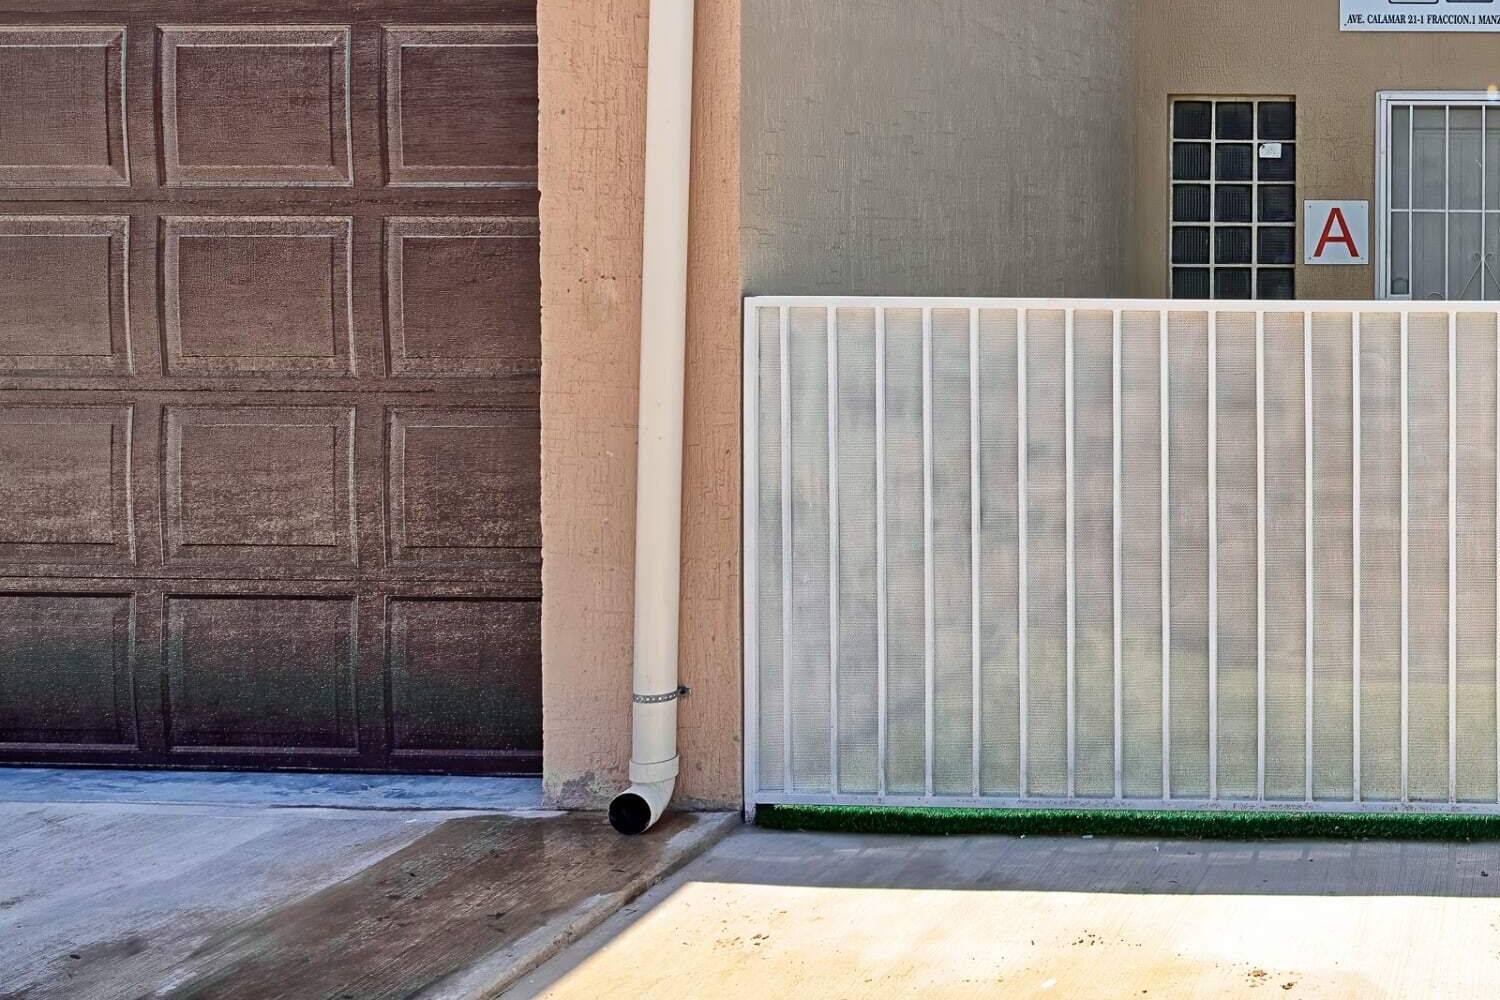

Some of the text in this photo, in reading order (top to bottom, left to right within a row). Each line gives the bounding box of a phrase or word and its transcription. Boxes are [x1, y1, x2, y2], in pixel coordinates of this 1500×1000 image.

[1347, 14, 1365, 25] AVE.
[1367, 14, 1406, 25] CALAMAR
[1408, 14, 1425, 25] 21-1
[1313, 207, 1360, 258] A
